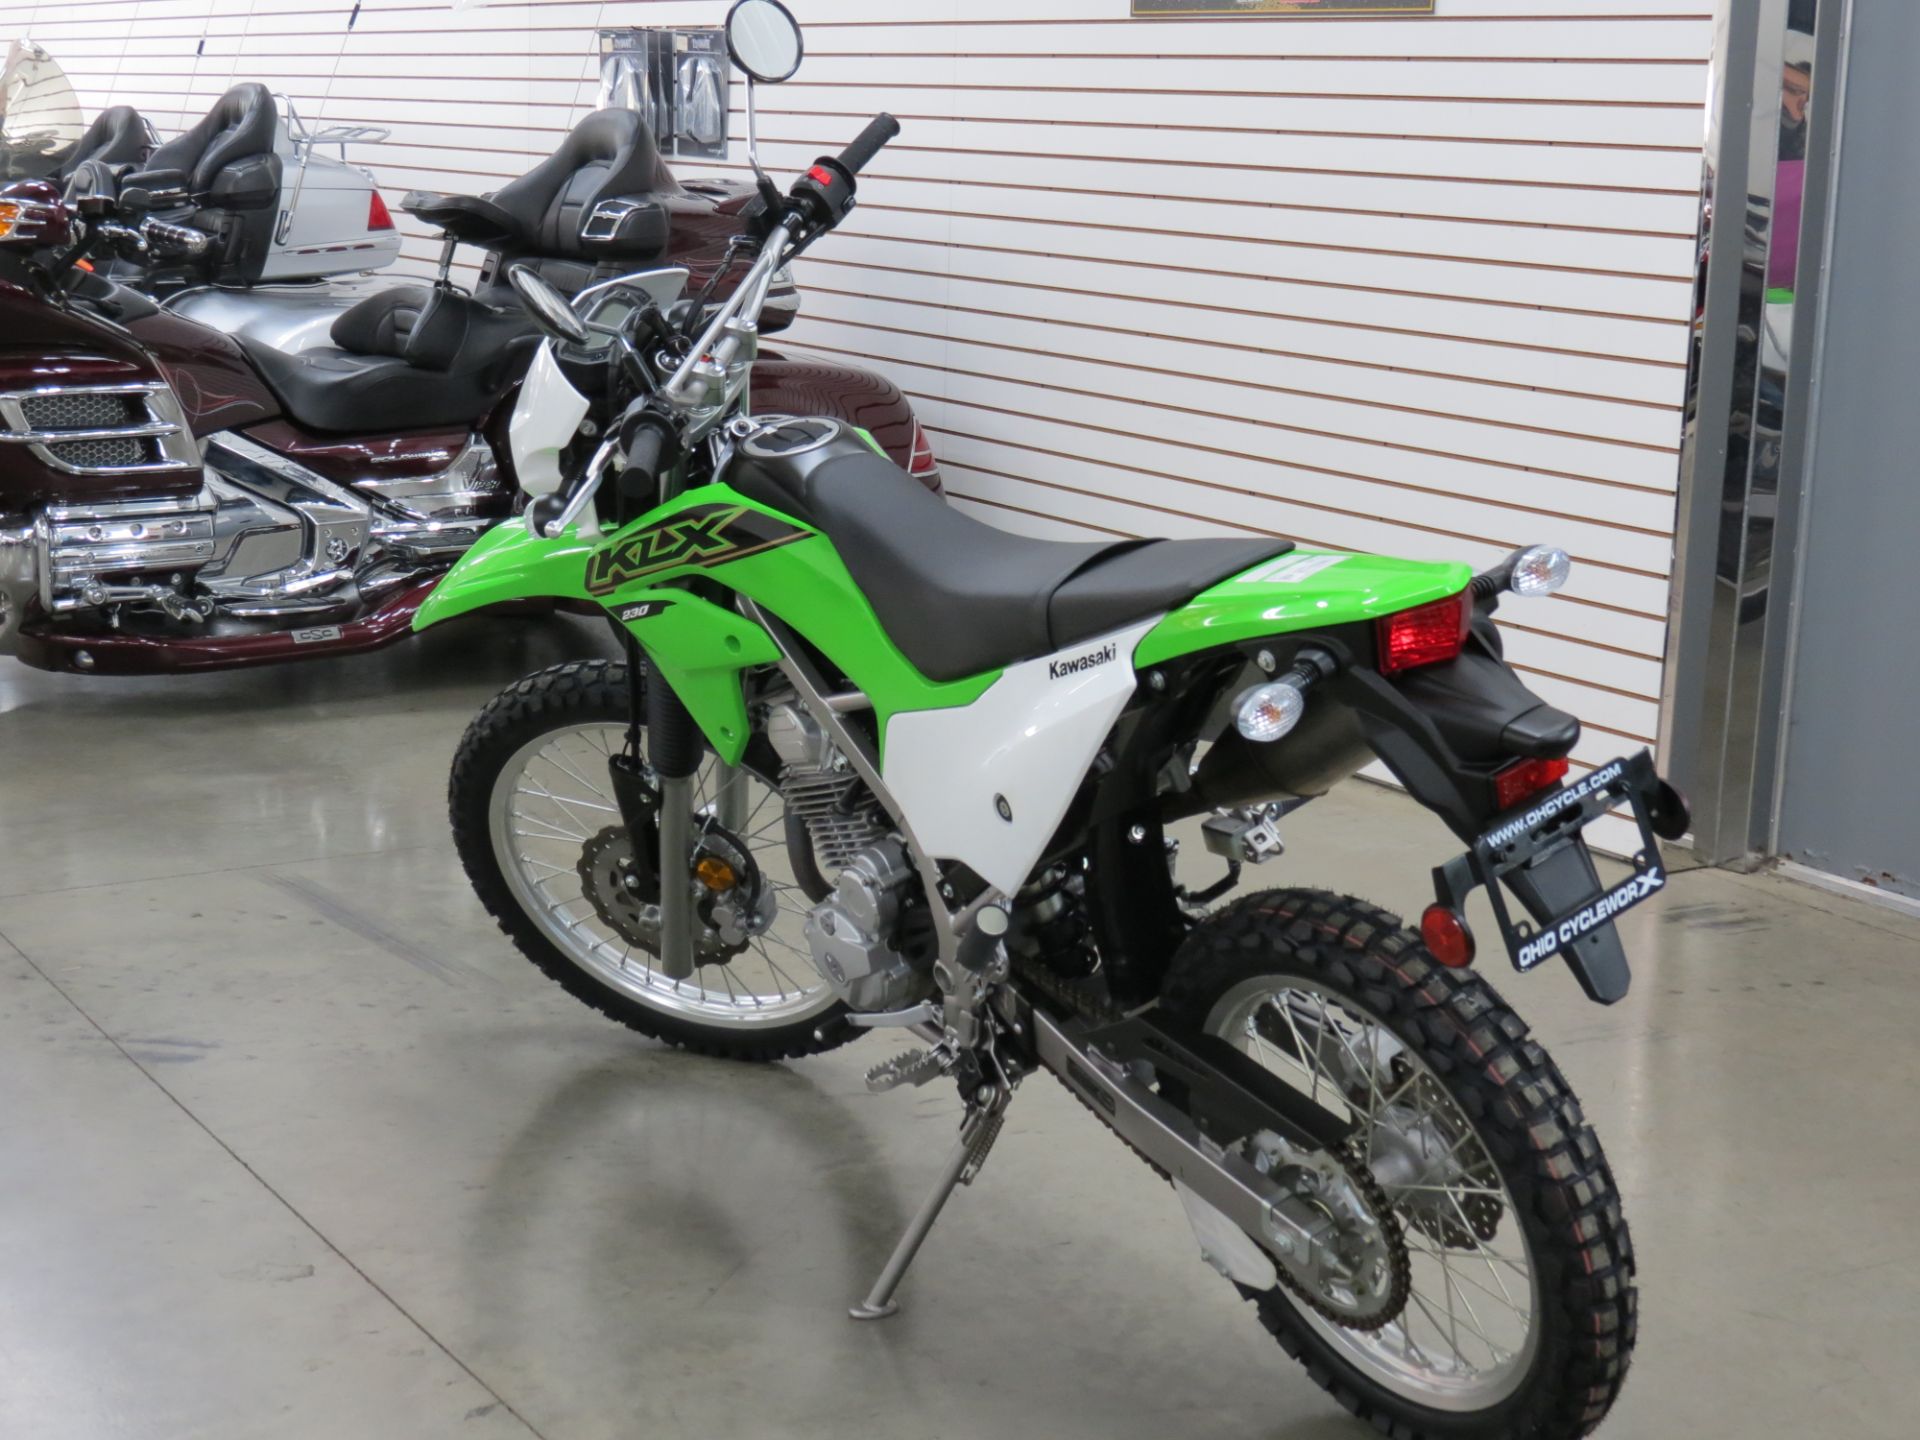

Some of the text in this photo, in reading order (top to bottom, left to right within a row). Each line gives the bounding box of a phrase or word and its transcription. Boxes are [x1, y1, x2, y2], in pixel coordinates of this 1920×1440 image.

[591, 506, 747, 584] KLX
[621, 604, 650, 620] 230
[1049, 643, 1117, 680] Kawasaki
[1487, 763, 1622, 848] WWW.OHCYCLE.COM
[1518, 867, 1664, 967] OHIO CYCLEWORX
